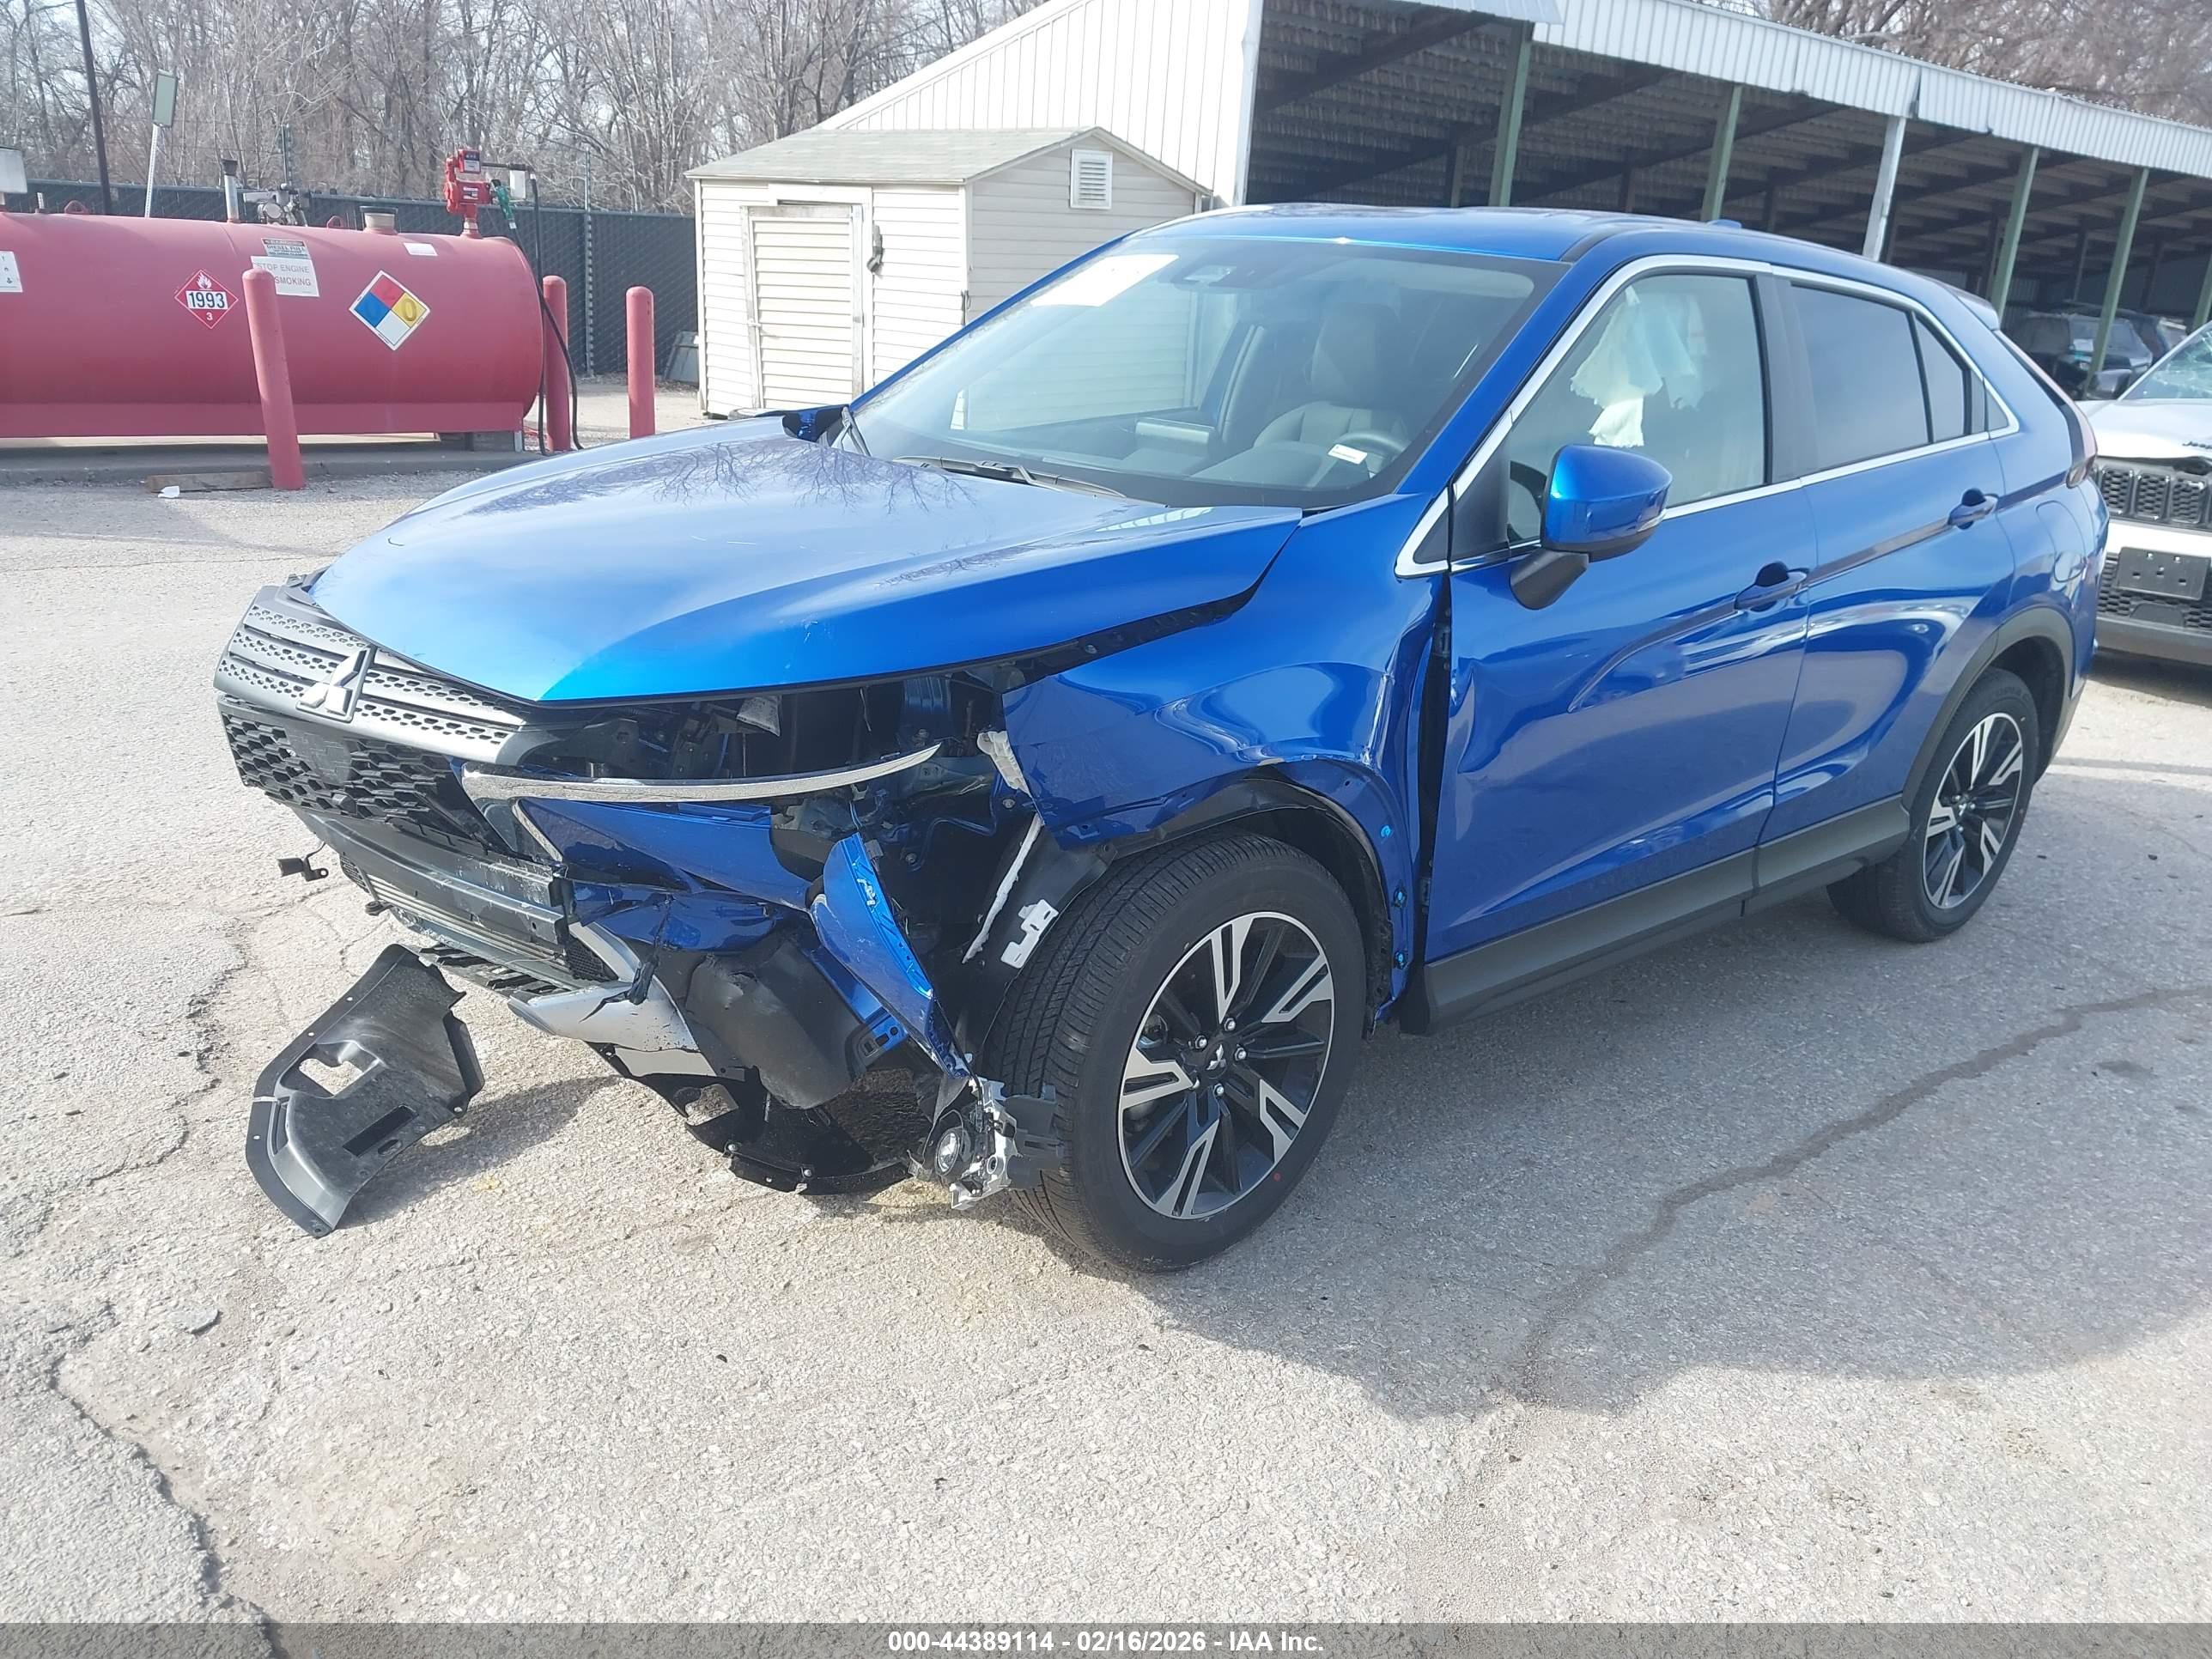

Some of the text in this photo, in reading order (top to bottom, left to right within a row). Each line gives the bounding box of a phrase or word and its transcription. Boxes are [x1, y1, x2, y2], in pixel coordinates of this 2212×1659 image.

[257, 263, 310, 274] STOP ENGINE
[275, 276, 311, 287] SMOKING
[189, 292, 225, 308] 1993
[206, 313, 213, 321] 3
